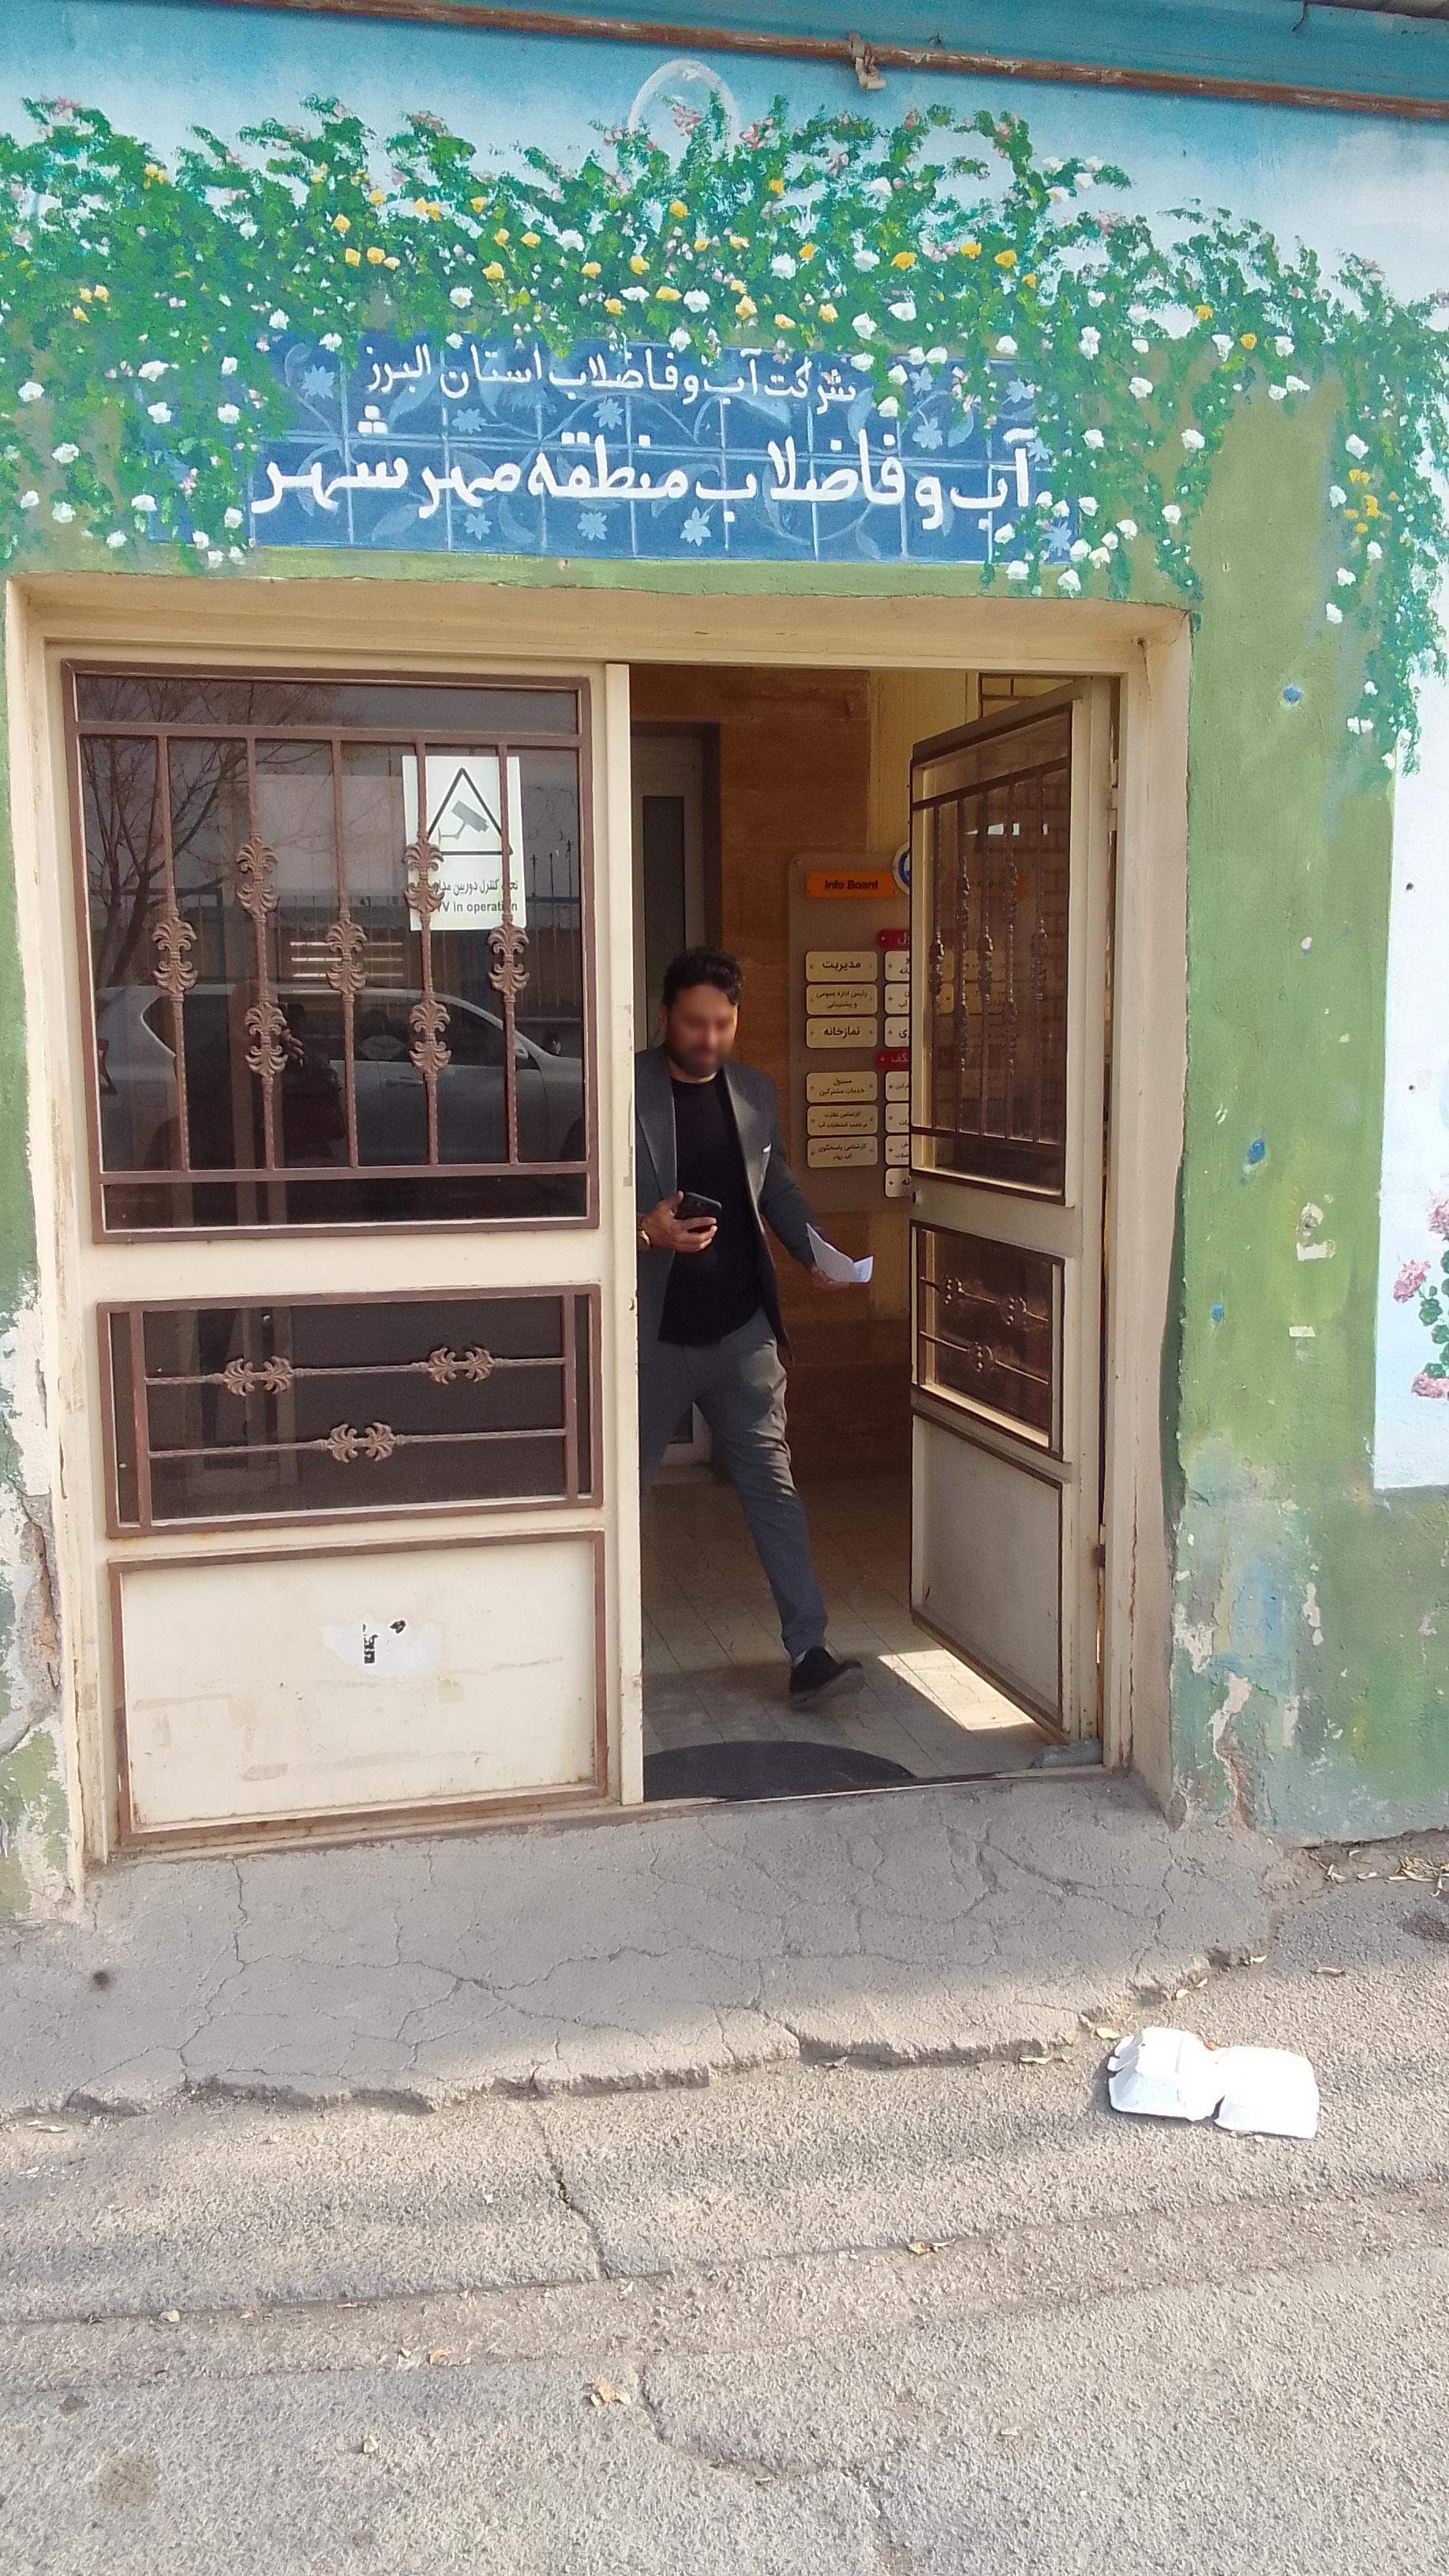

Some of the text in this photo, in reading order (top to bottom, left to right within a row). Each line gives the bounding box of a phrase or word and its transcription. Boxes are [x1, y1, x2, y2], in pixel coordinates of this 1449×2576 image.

[365, 343, 856, 415] شرکت آب و فاضلاب استان البرز
[526, 430, 689, 499] منطقه
[695, 428, 906, 523] فاضلاب
[949, 427, 1037, 531] آب
[914, 475, 945, 531] و
[453, 880, 478, 897] دوربین
[480, 878, 499, 894] کنترل
[825, 878, 878, 889] Info Board
[453, 901, 463, 912] in
[822, 960, 861, 972] مدیریت
[823, 1026, 860, 1039] نمازخانه
